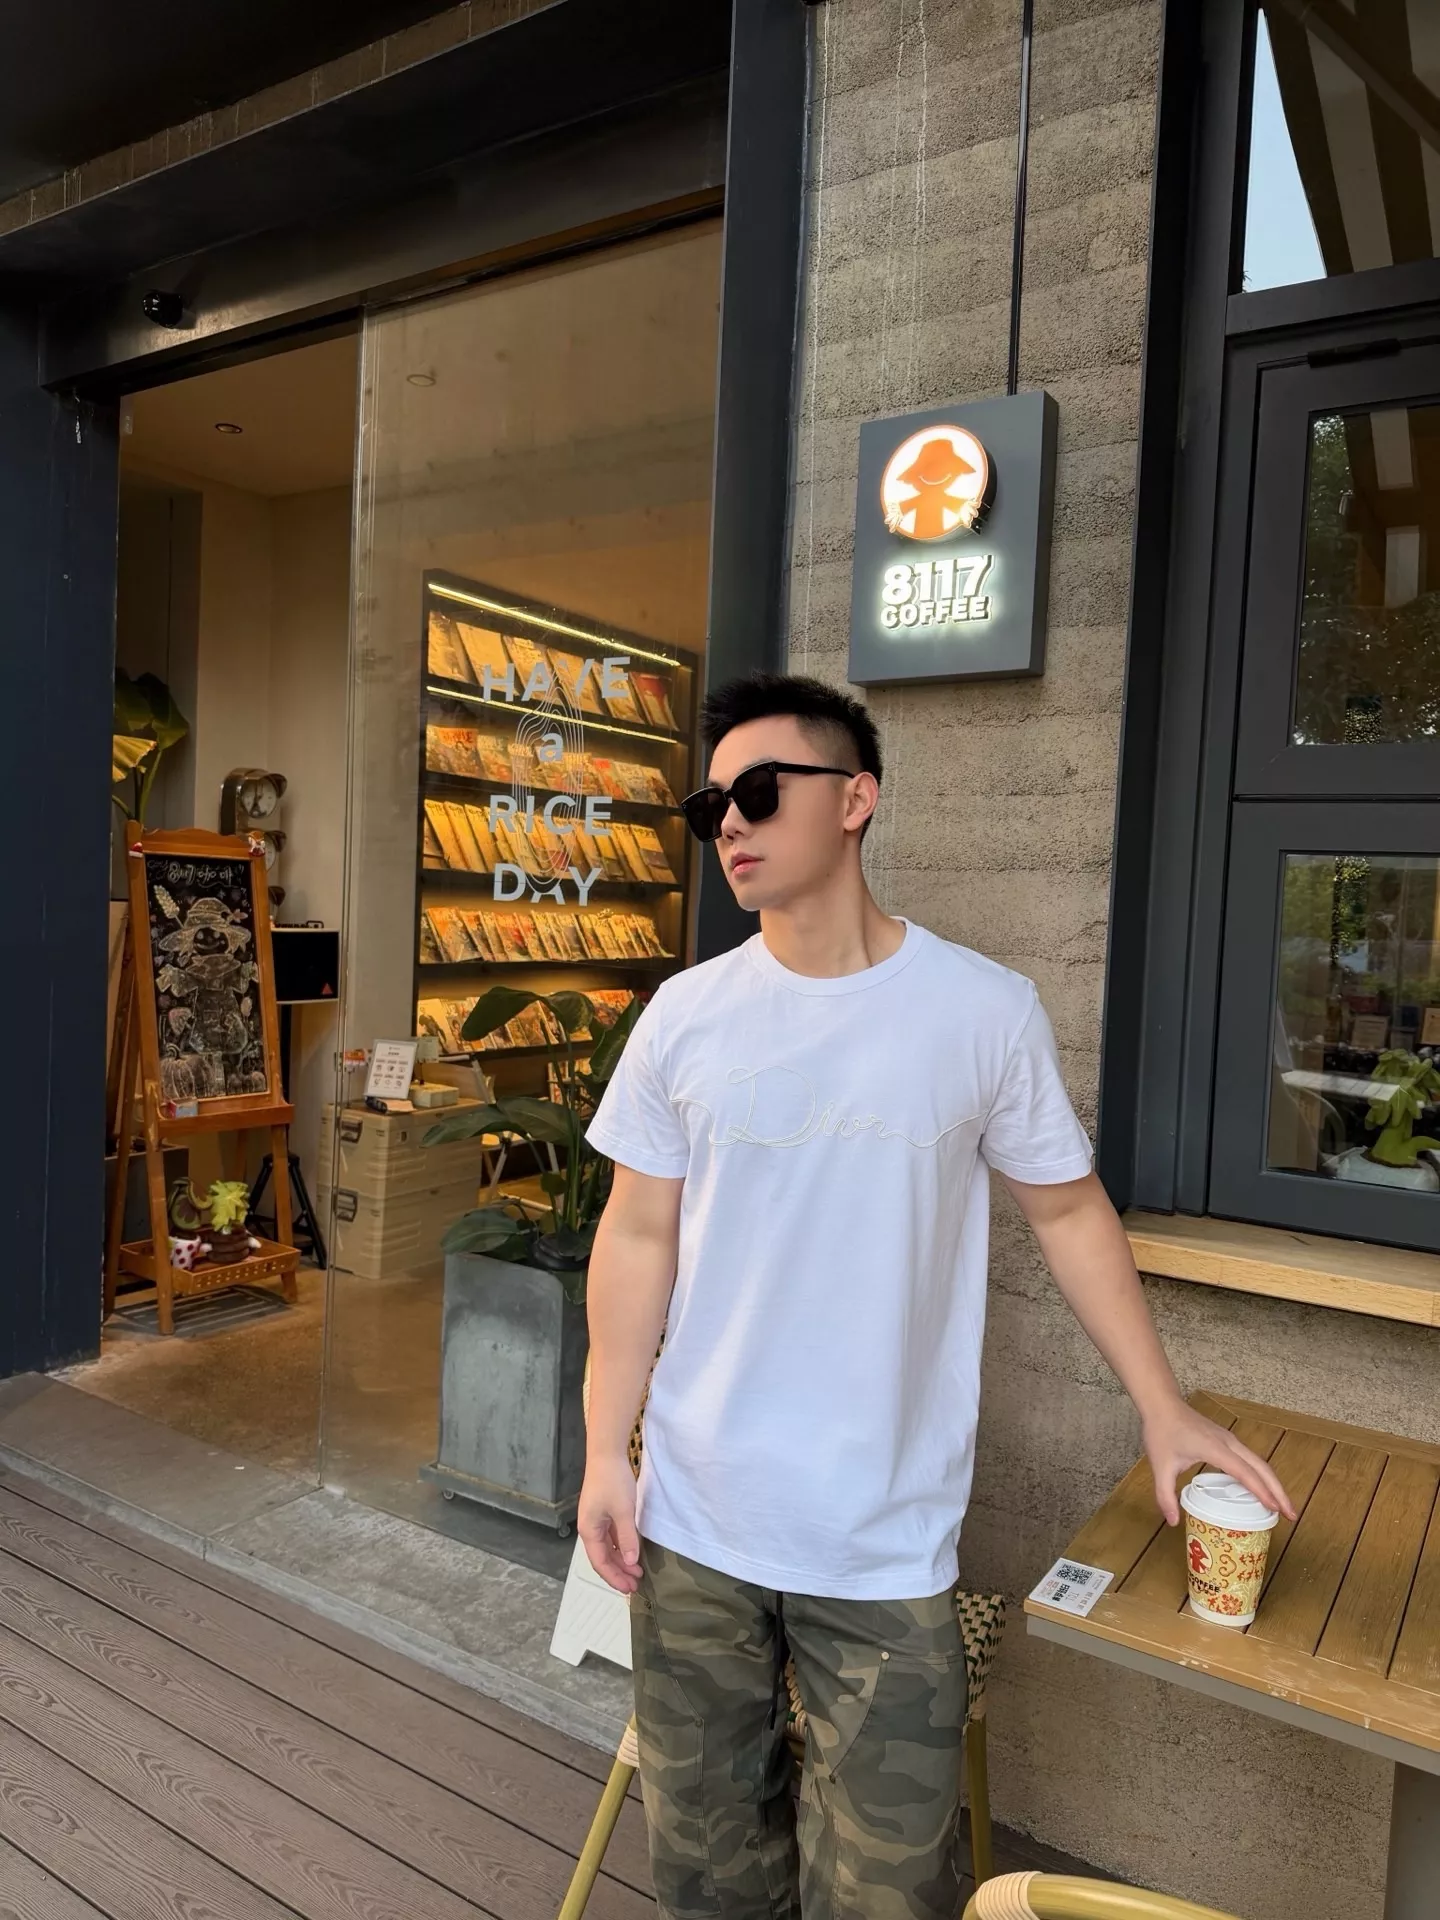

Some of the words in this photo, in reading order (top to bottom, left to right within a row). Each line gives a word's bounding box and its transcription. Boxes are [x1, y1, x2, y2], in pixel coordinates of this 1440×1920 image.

[880, 555, 993, 605] 8117
[880, 596, 992, 629] COFFEE
[483, 656, 632, 703] HAVE
[539, 733, 563, 762] a
[489, 795, 614, 837] RICE
[493, 863, 604, 907] DAY
[708, 1064, 900, 1149] Dior
